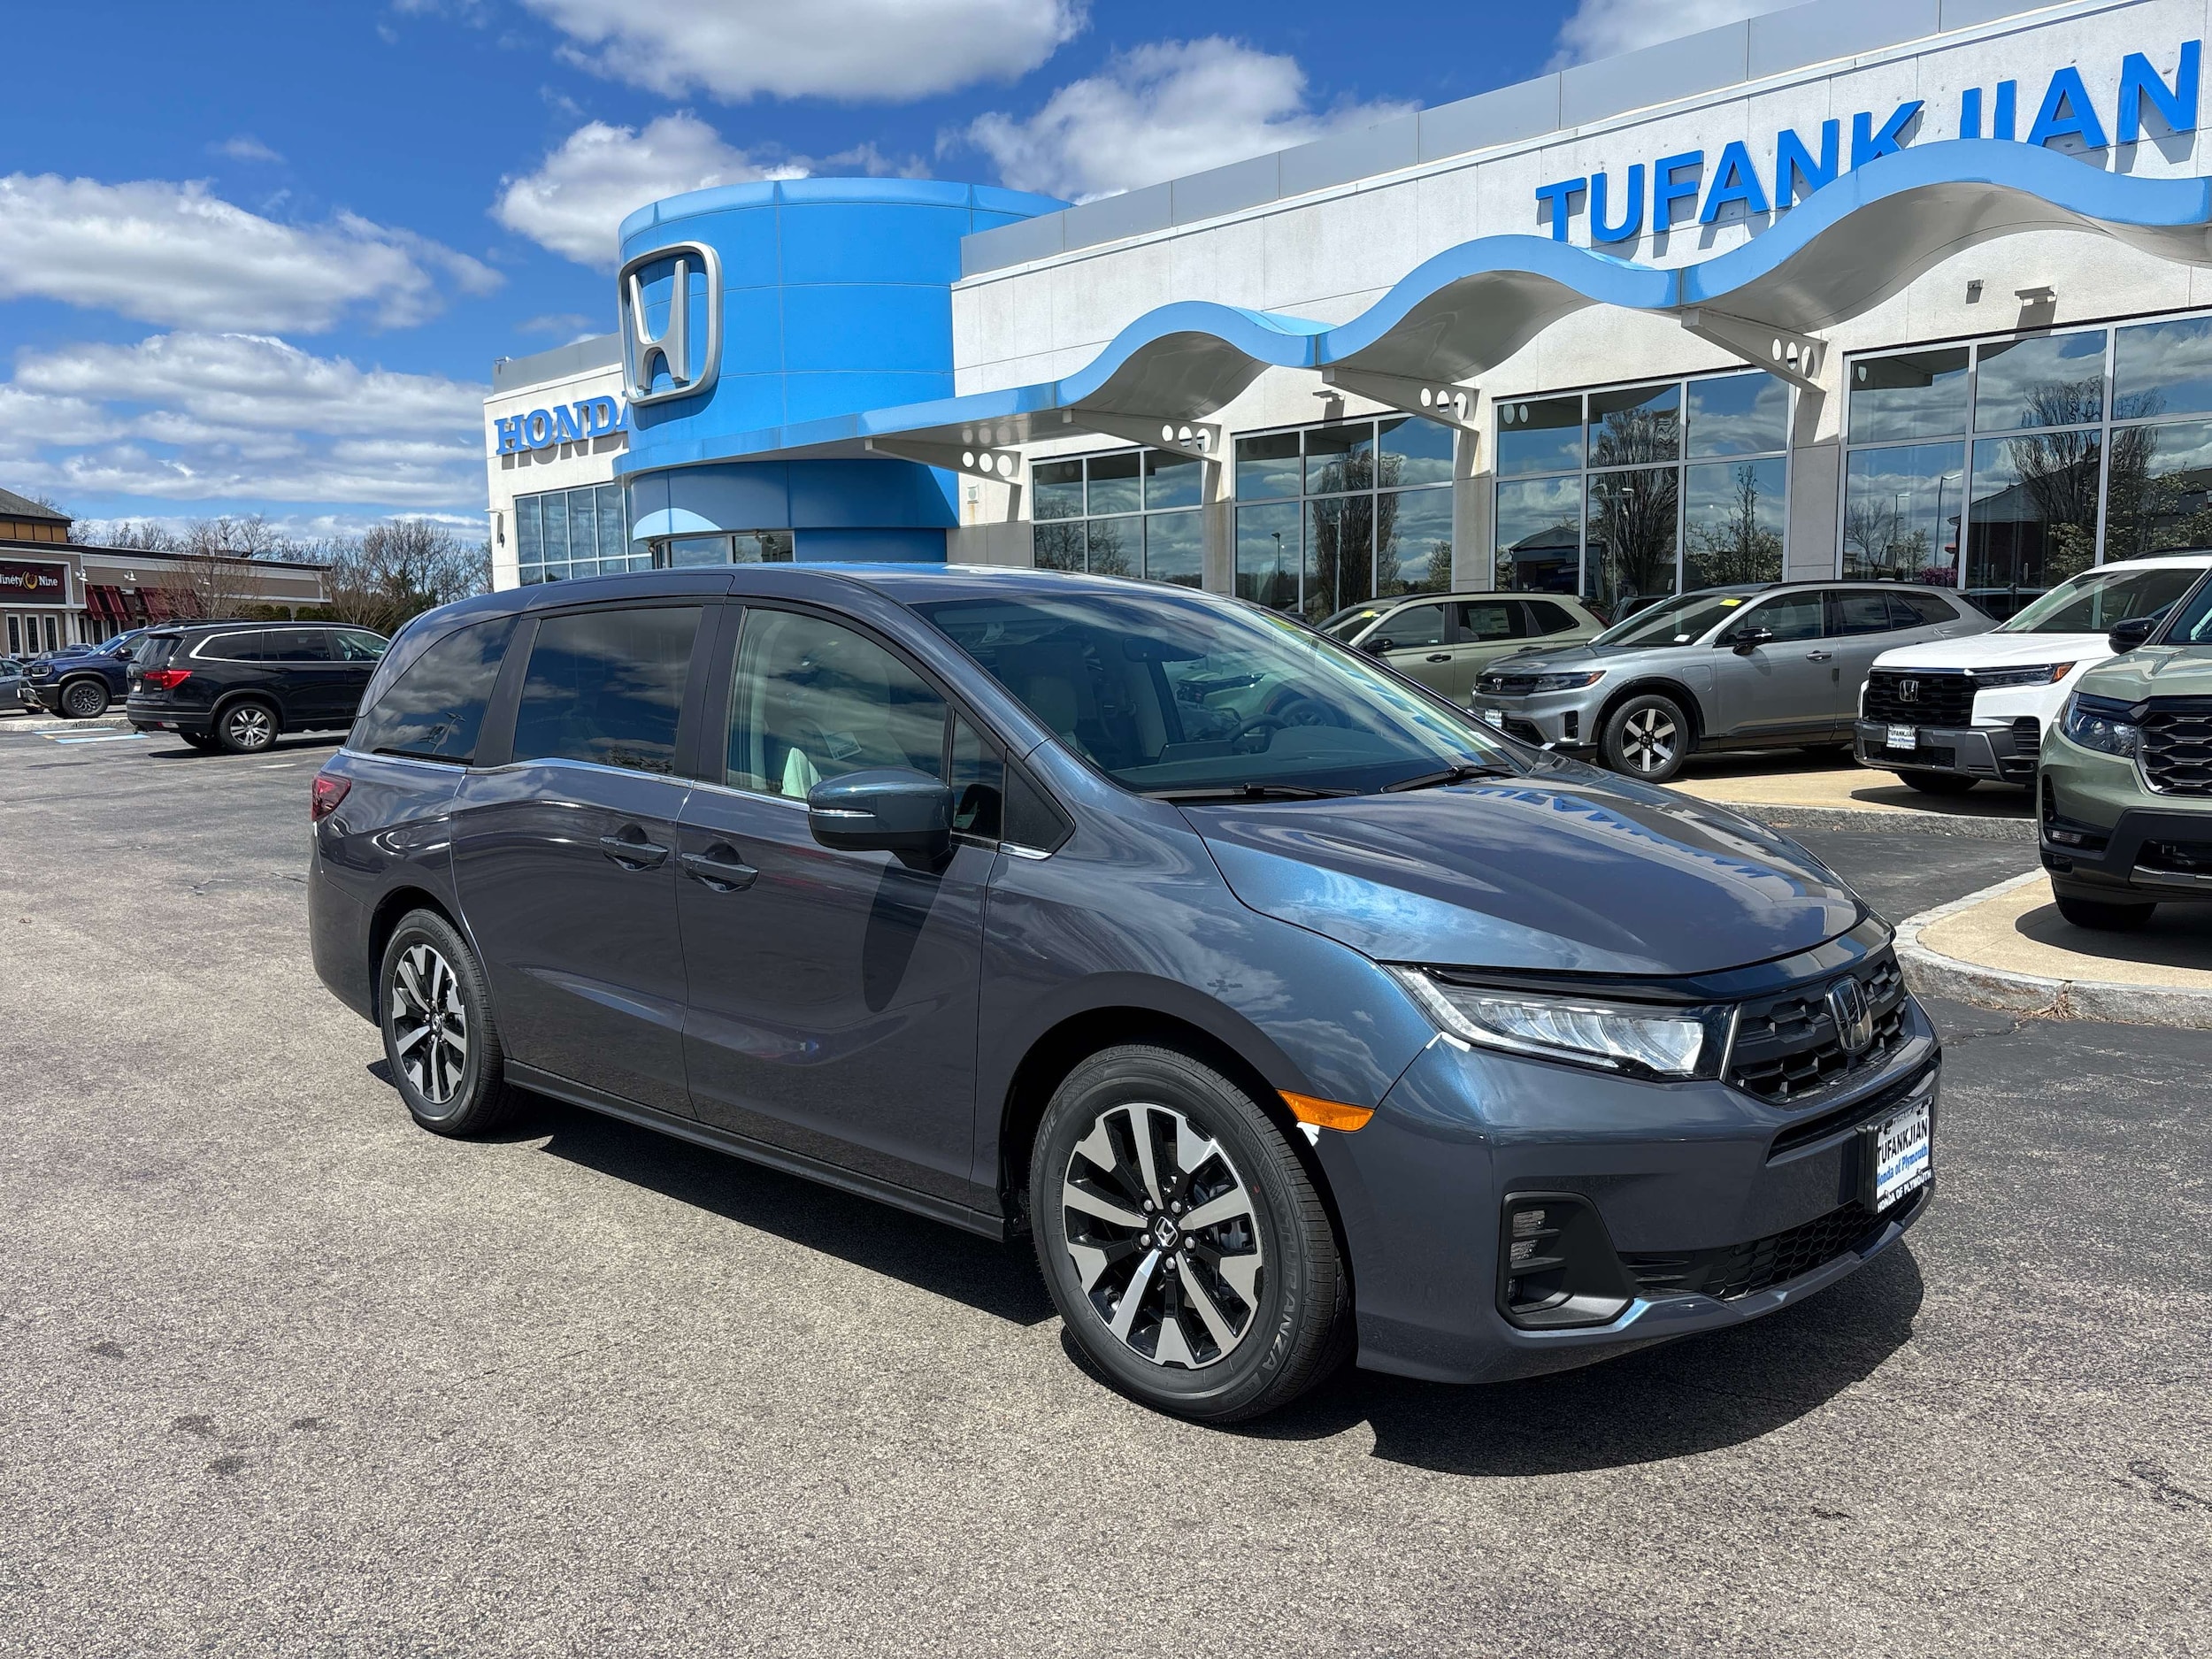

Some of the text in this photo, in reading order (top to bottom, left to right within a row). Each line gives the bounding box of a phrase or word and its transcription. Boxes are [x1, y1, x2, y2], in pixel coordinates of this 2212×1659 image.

[38, 575, 58, 587] Nine
[1877, 1117, 1928, 1167] TUFANKJIAN
[1895, 1158, 1901, 1175] of
[1901, 1142, 1928, 1171] Plymouth
[1877, 1169, 1932, 1213] HONDA OF PLYMOUTH
